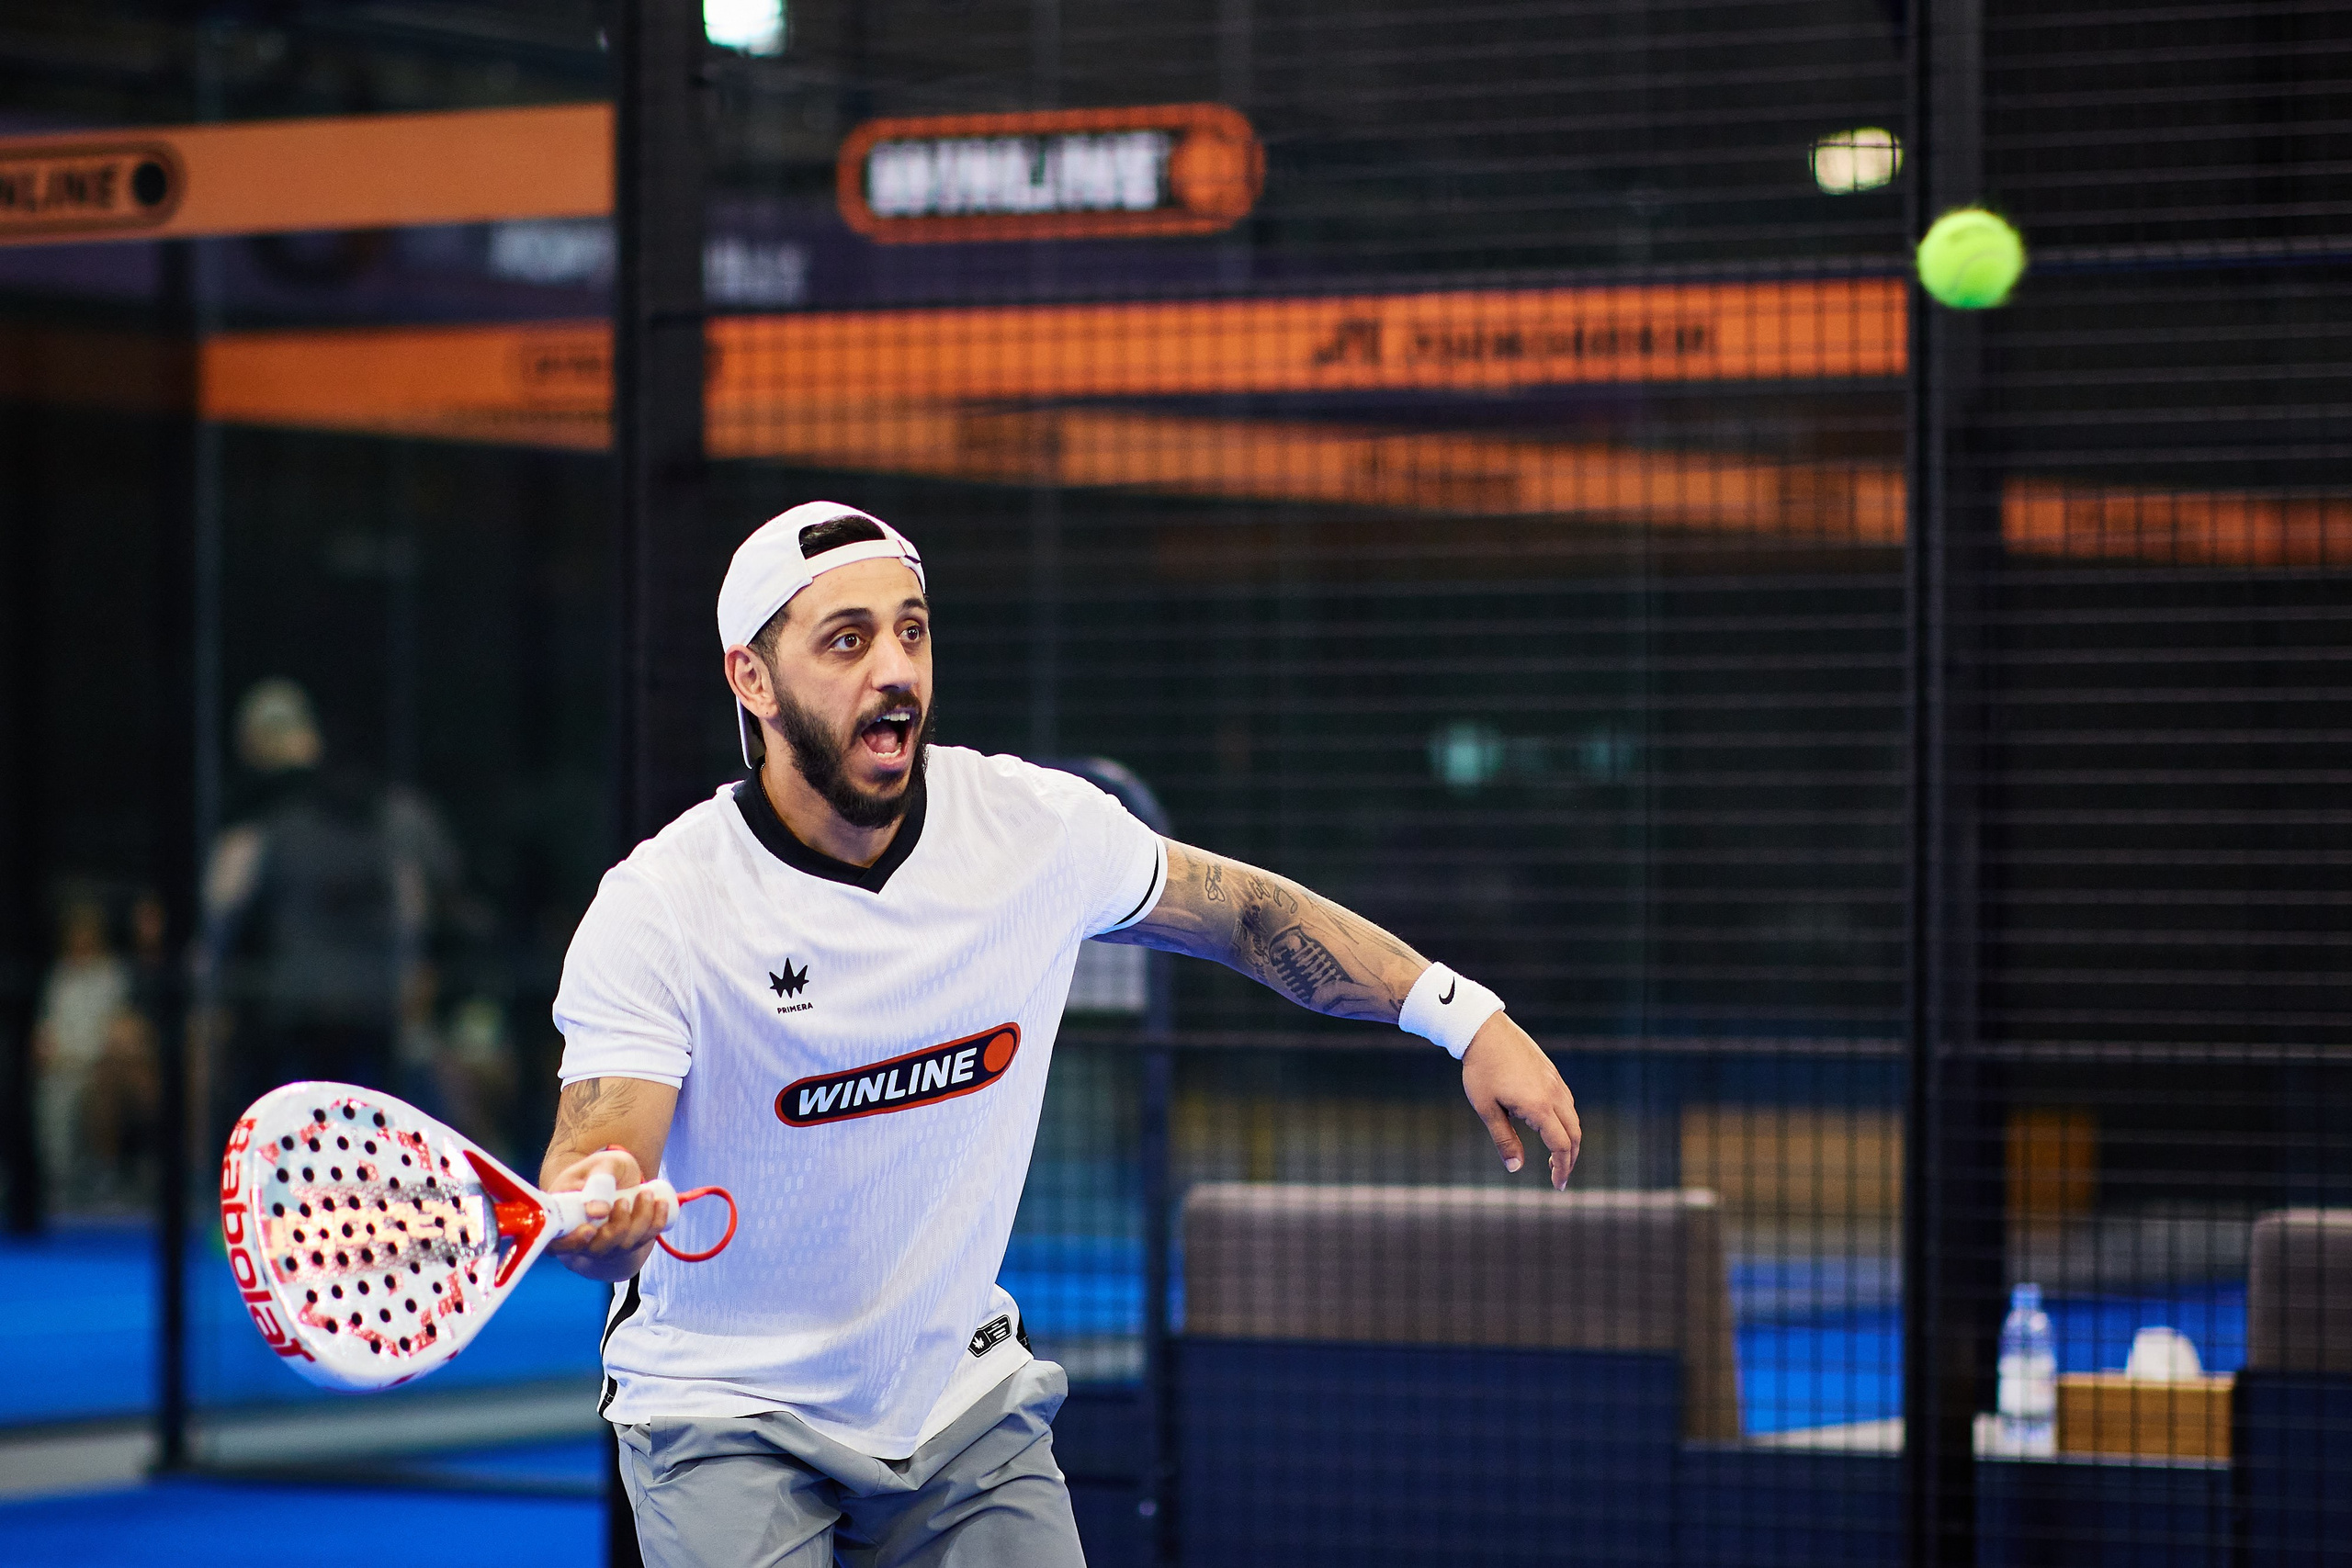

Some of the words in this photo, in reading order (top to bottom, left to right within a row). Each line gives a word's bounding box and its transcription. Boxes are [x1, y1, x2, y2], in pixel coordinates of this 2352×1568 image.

[777, 1002, 813, 1014] PRIMERA
[798, 1047, 977, 1116] WINLINE
[220, 1118, 315, 1363] Babolat
